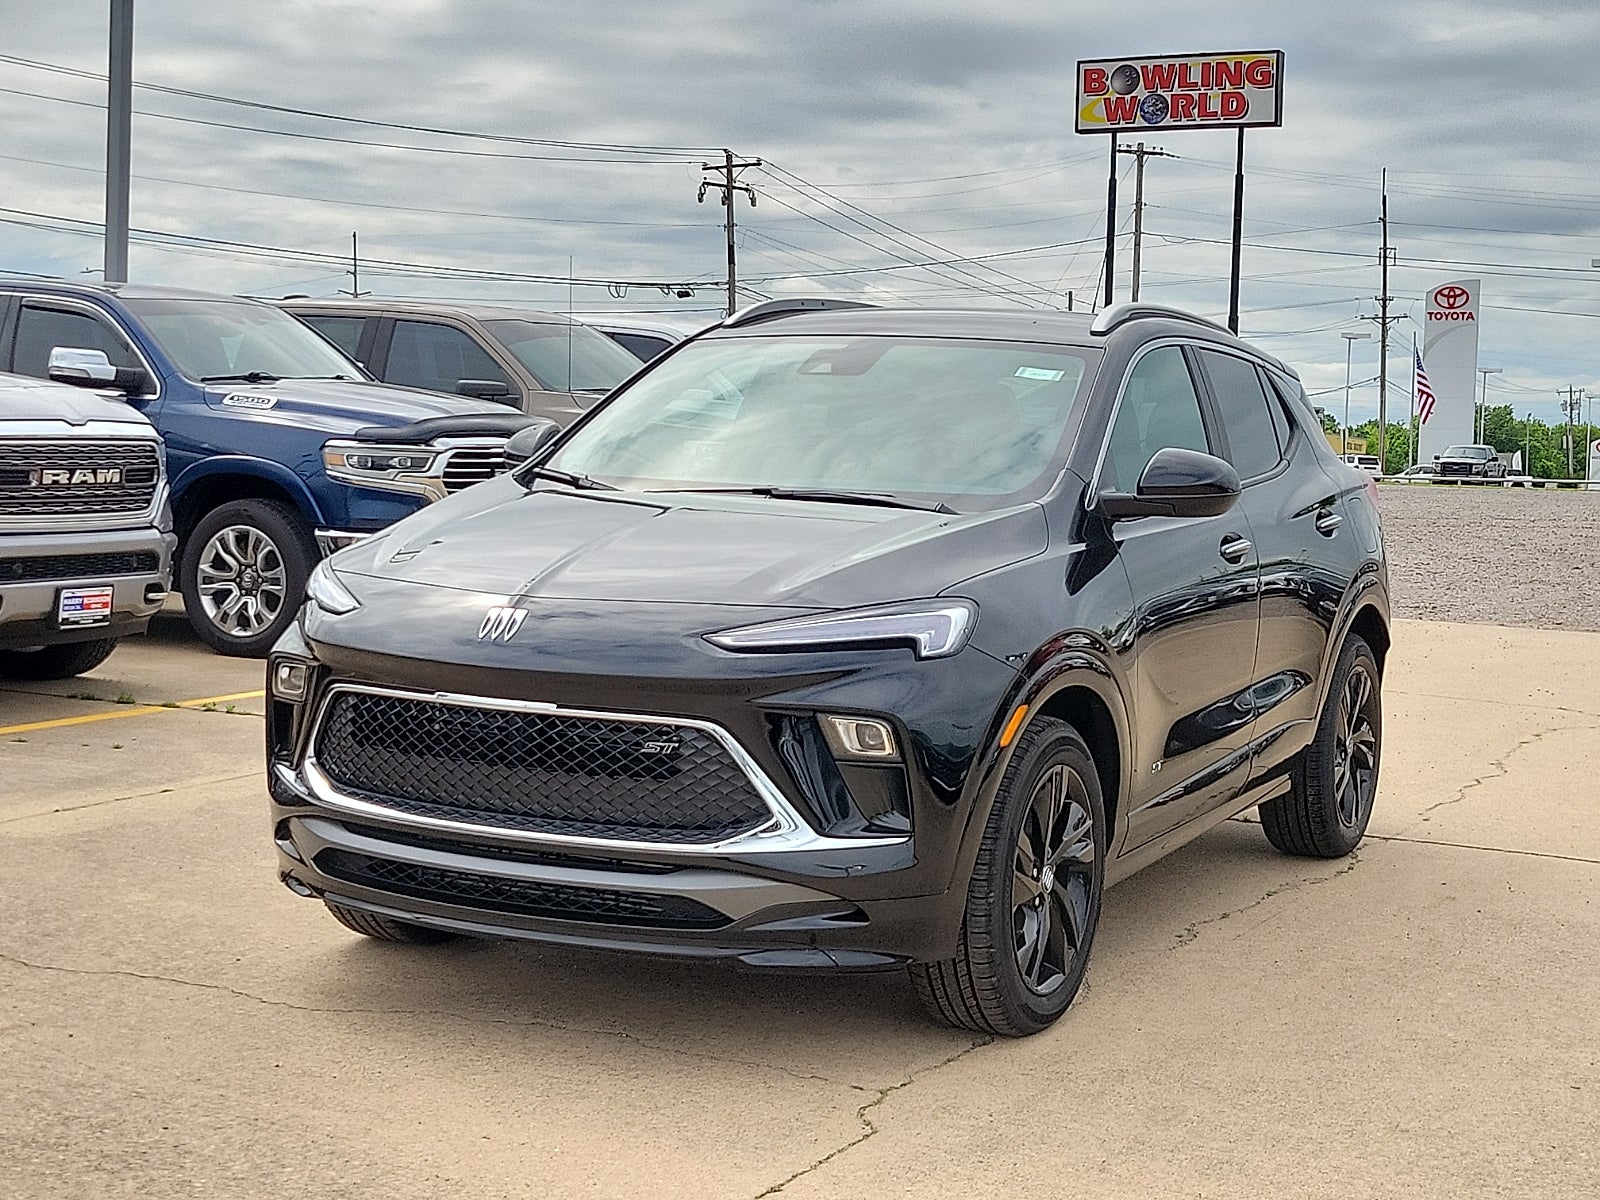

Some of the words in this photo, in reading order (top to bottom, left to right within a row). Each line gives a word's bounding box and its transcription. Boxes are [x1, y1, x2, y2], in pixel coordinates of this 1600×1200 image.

[1083, 59, 1274, 96] BOWLING
[1103, 91, 1249, 125] WORLD
[1427, 312, 1475, 321] TOYOTA
[42, 469, 120, 484] RAM
